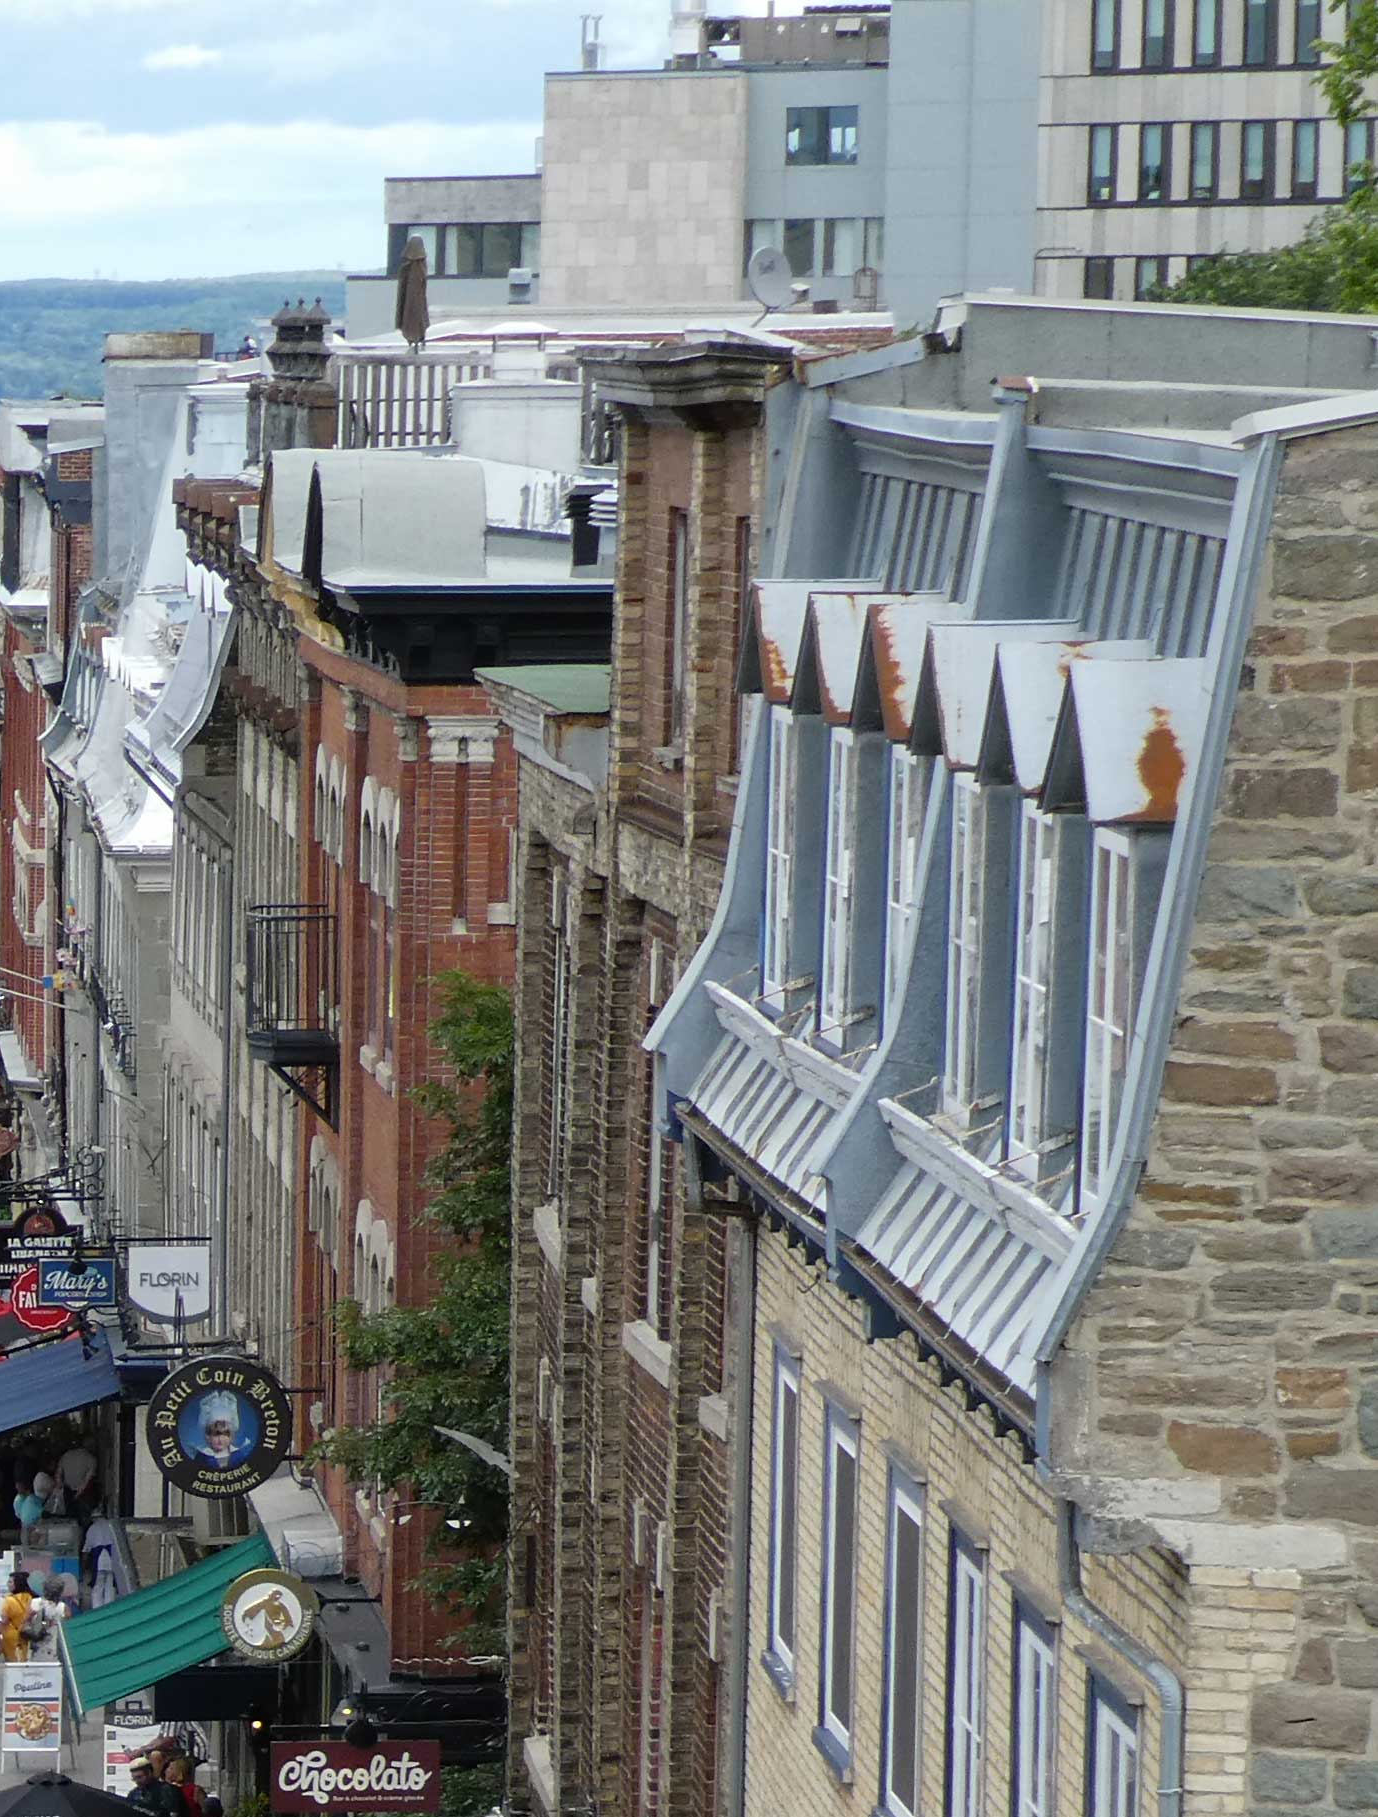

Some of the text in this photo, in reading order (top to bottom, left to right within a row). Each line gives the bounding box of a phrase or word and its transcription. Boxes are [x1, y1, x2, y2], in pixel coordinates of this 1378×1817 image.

[7, 1236, 72, 1248] LA GALETTE
[44, 1270, 108, 1297] Mary's
[139, 1271, 199, 1288] FLORIN
[196, 1367, 245, 1387] Coin
[246, 1378, 281, 1450] Breton
[191, 1471, 262, 1494] RESTAURANT
[13, 1680, 53, 1693] Poutine
[114, 1715, 153, 1725] FLORIN
[278, 1750, 433, 1805] Chocolato
